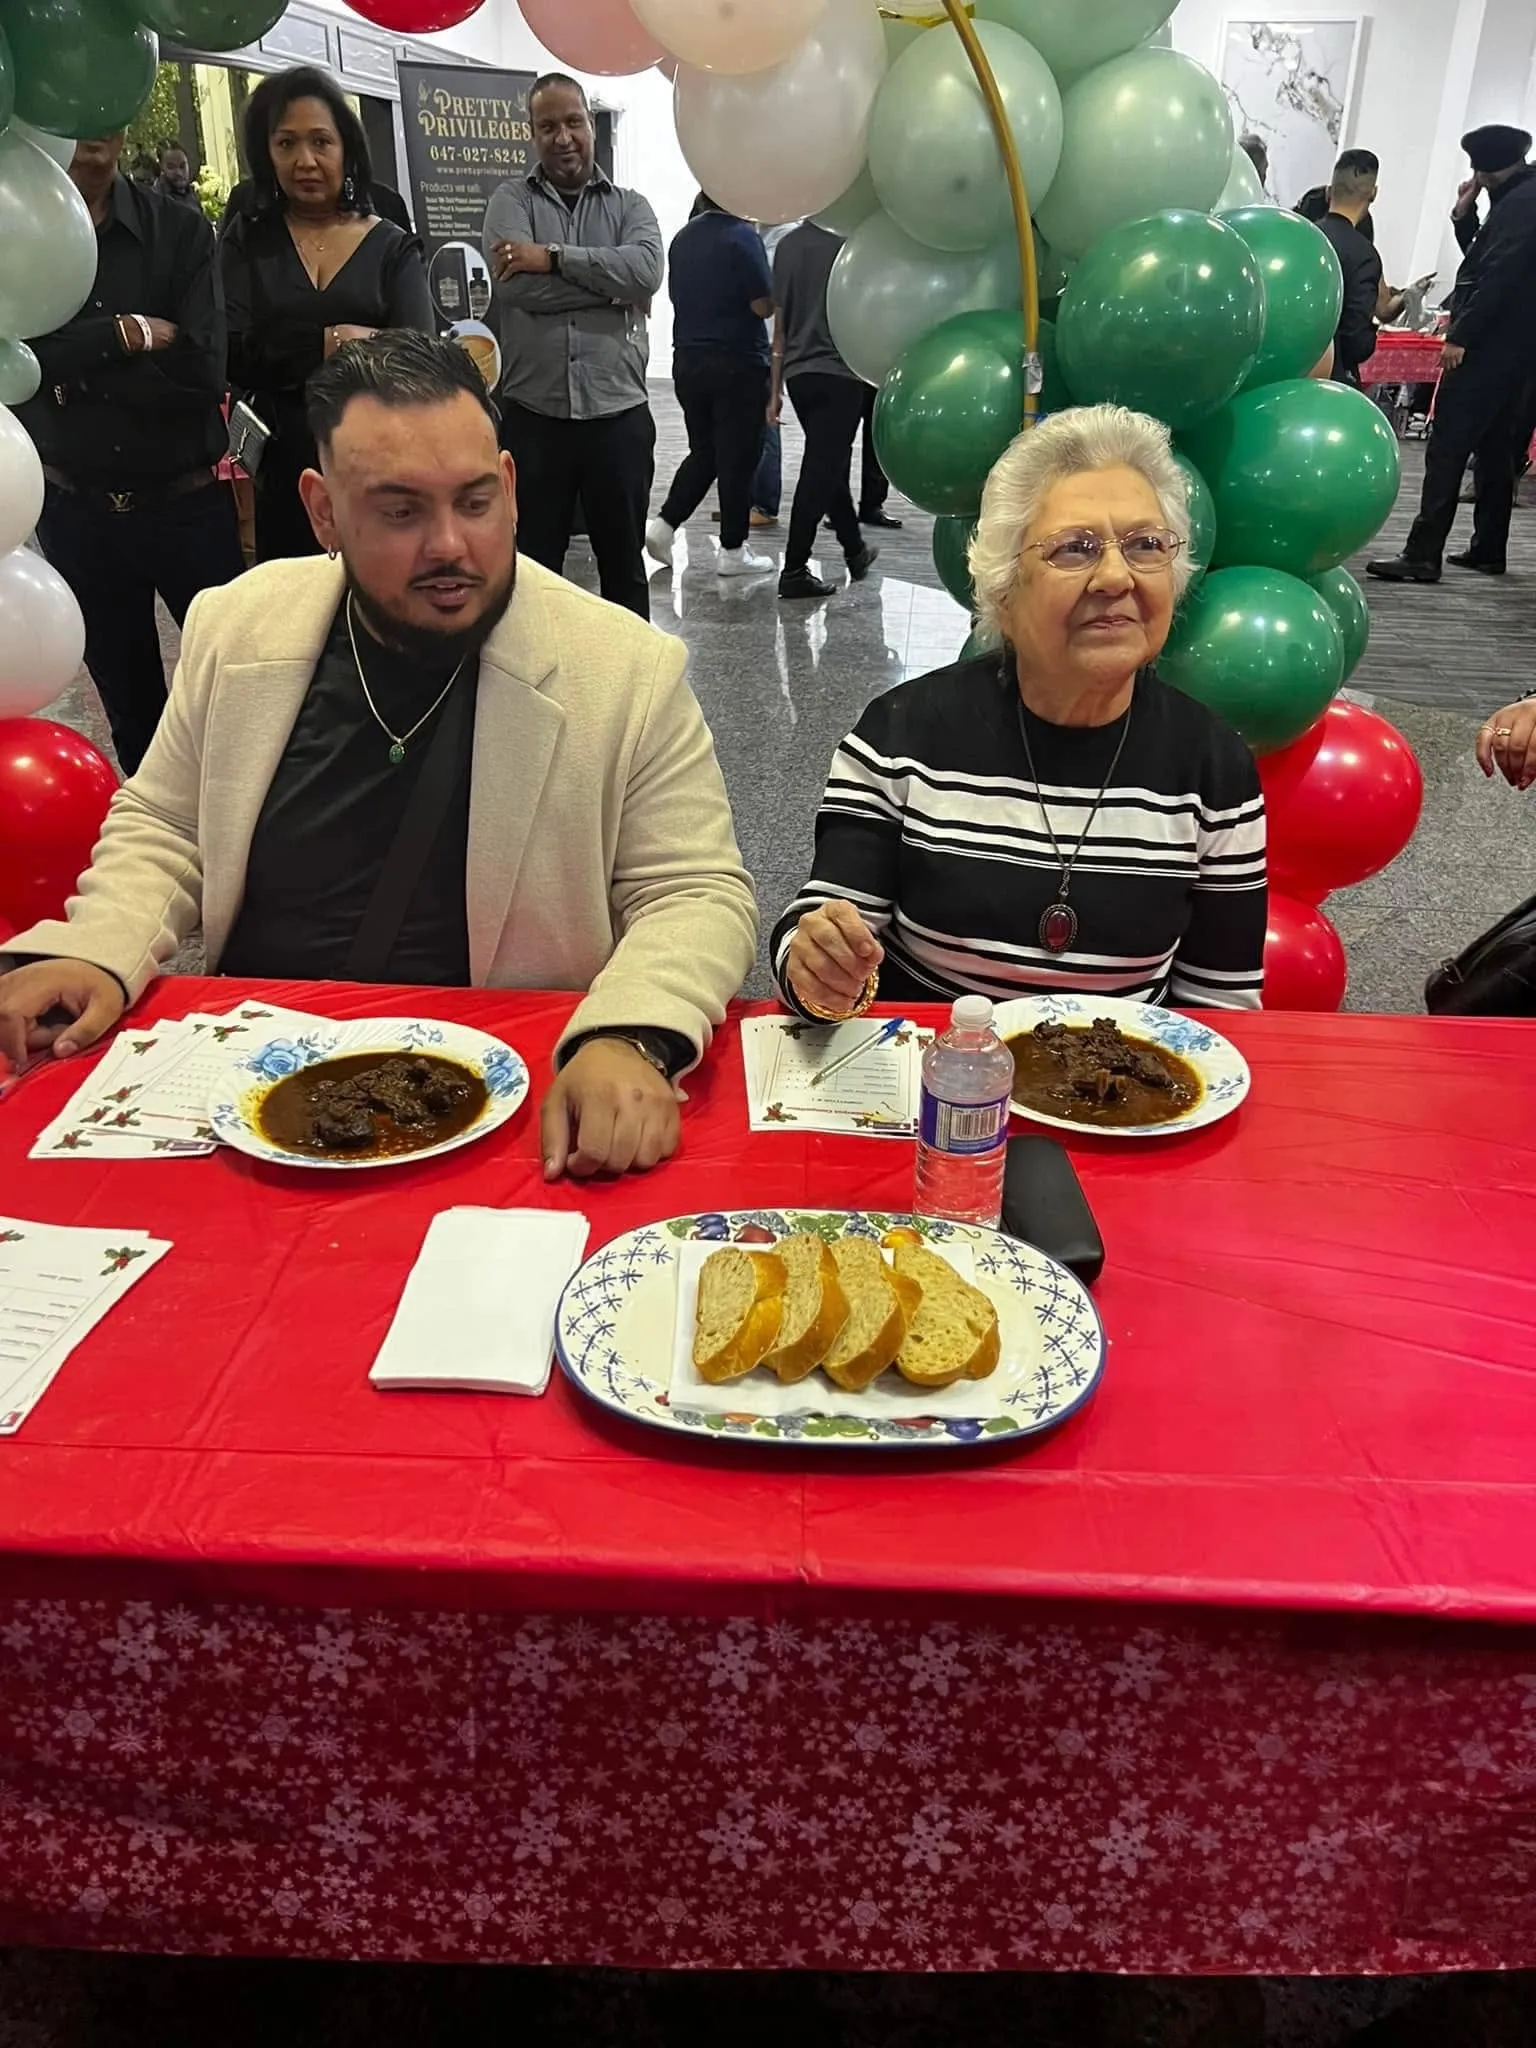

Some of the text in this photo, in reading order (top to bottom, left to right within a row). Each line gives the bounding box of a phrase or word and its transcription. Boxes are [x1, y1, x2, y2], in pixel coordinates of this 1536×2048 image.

[433, 88, 512, 119] PRETTY
[417, 110, 532, 142] PRIVILEGES
[420, 180, 454, 194] Products
